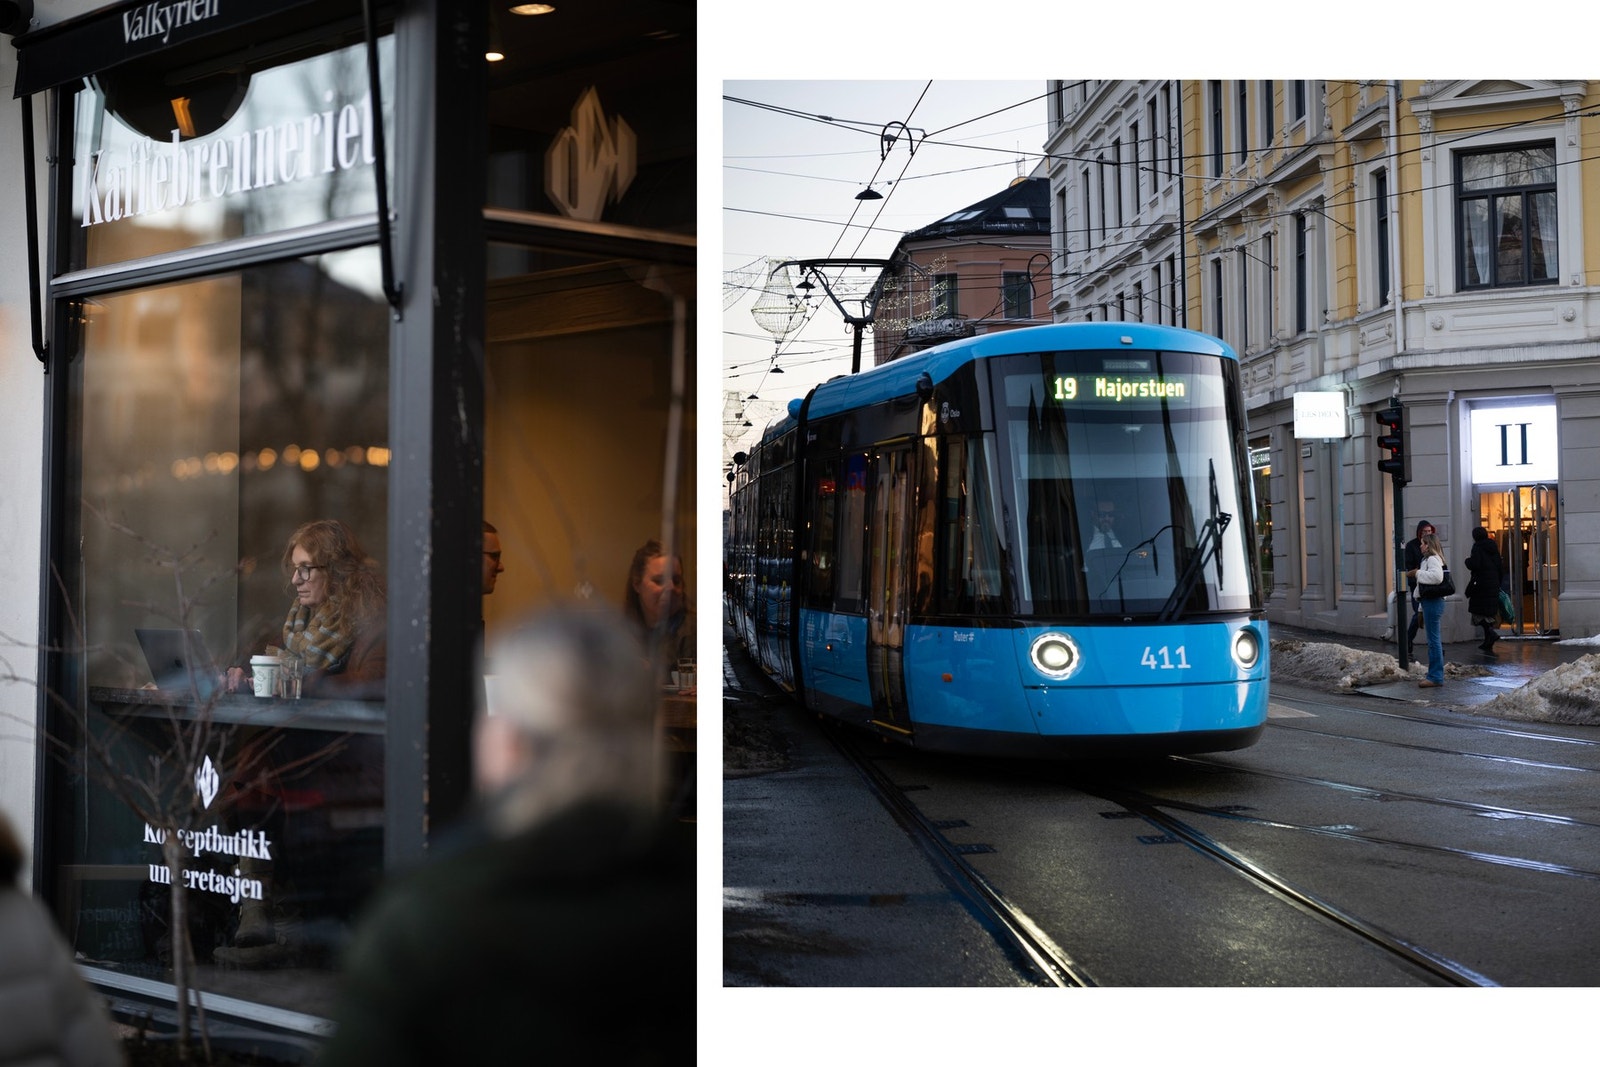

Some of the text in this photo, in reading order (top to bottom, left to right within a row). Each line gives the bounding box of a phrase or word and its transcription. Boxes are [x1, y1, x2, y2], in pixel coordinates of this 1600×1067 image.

[80, 90, 376, 227] Kaffebrenneriet
[1054, 377, 1185, 402] 19 Majorstuen
[1495, 422, 1533, 466] II
[1141, 645, 1192, 670] 411
[143, 822, 272, 860] Koseptbutikk
[149, 863, 263, 904] uneretasjen
